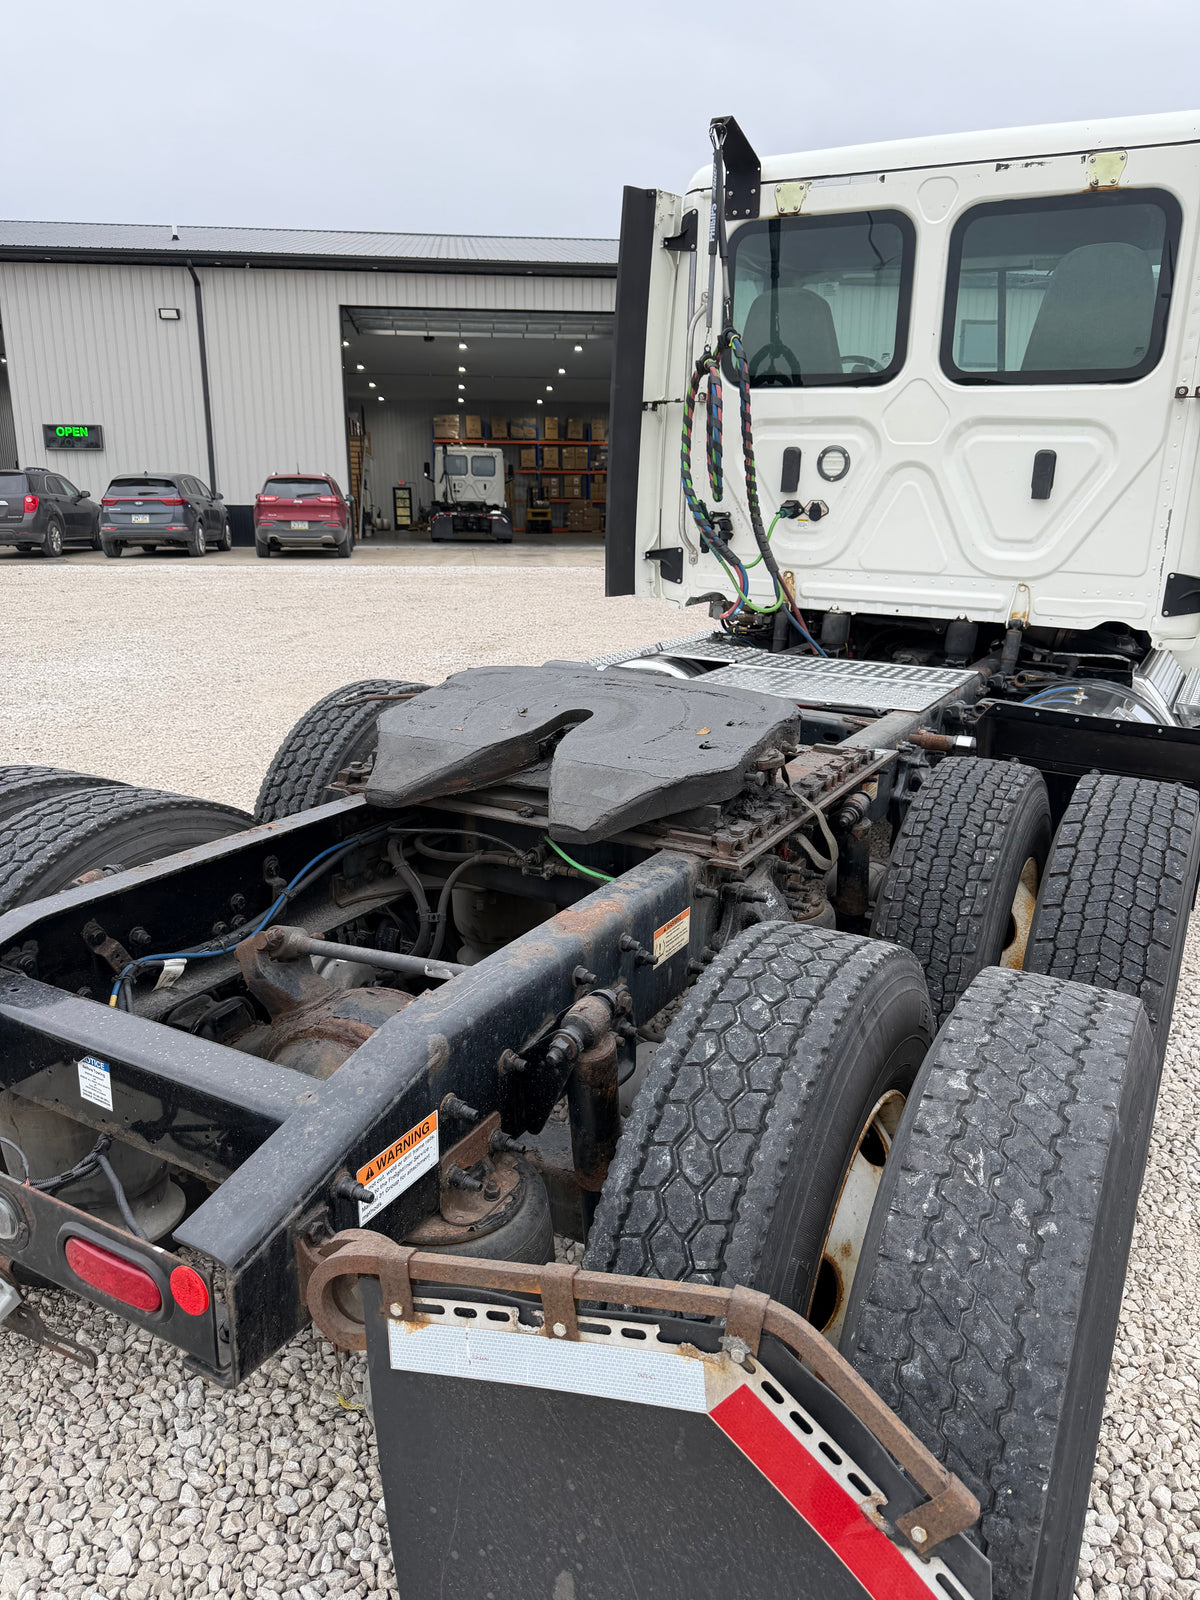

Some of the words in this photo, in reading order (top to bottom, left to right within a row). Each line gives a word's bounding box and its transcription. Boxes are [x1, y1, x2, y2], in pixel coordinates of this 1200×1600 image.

[55, 426, 89, 437] OPEN
[84, 1056, 105, 1070] OTICE
[376, 1121, 430, 1171] WARNING
[414, 1146, 430, 1160] Service
[386, 1164, 397, 1176] weld
[385, 1179, 400, 1193] Group
